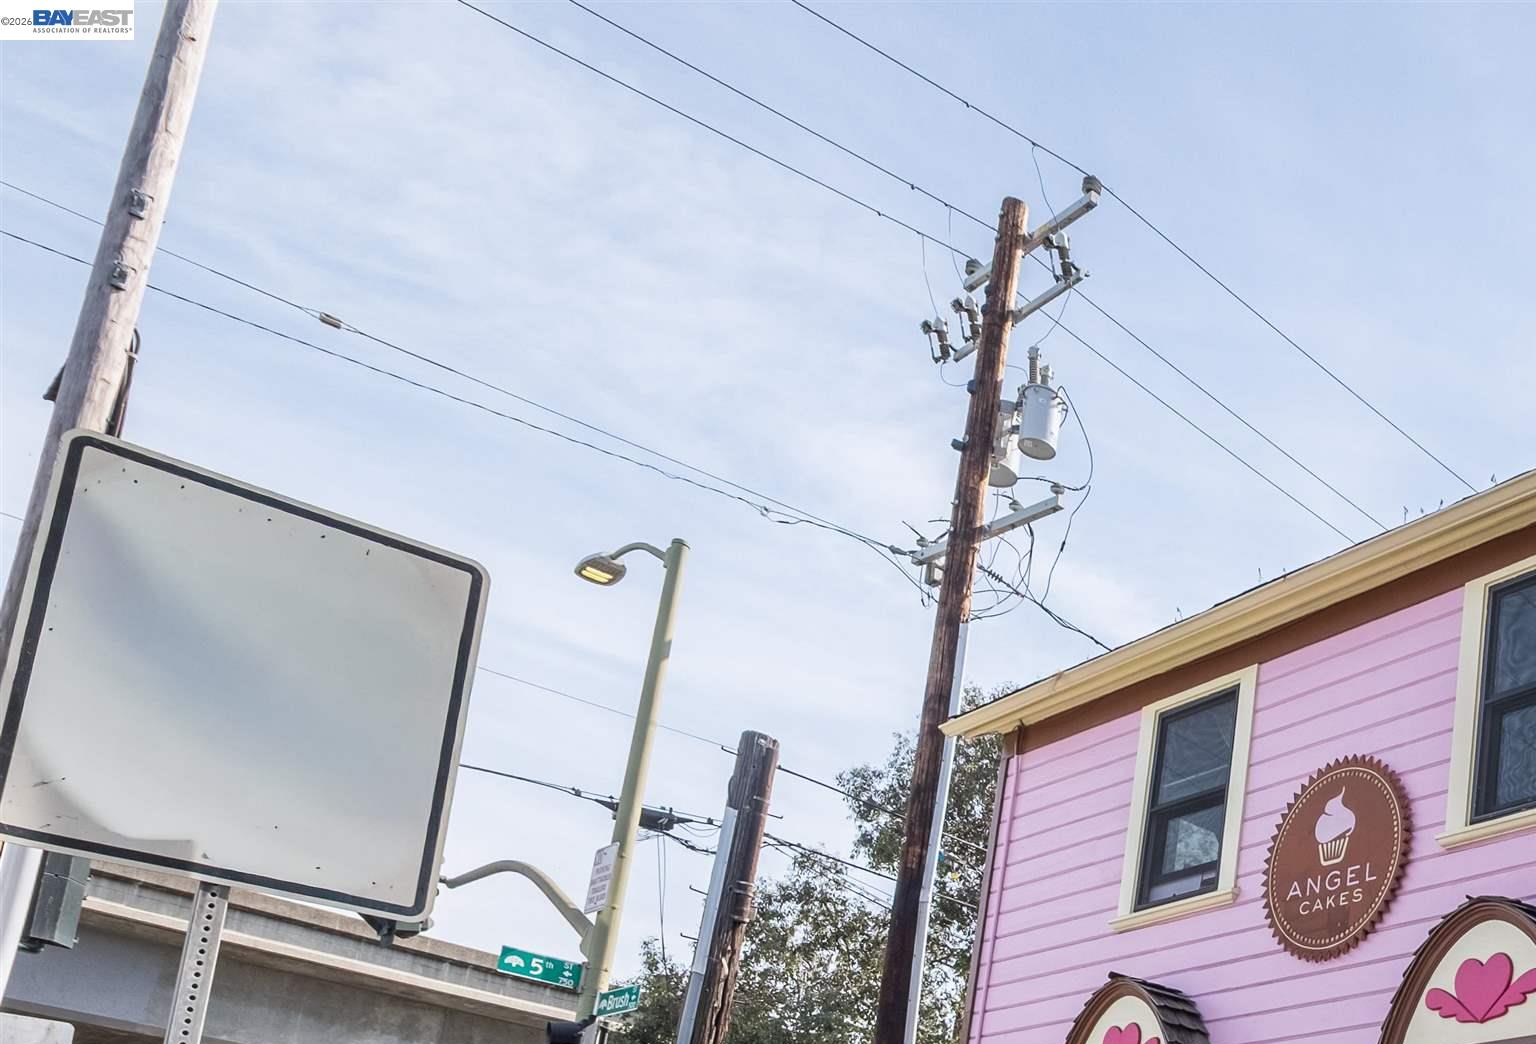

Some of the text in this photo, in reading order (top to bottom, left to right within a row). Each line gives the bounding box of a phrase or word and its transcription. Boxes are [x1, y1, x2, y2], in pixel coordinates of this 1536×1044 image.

[1287, 862, 1377, 901] ANGEL
[1299, 888, 1363, 915] CAKES
[529, 958, 554, 975] 5th
[559, 976, 574, 986] 750
[607, 992, 629, 1010] Brush
